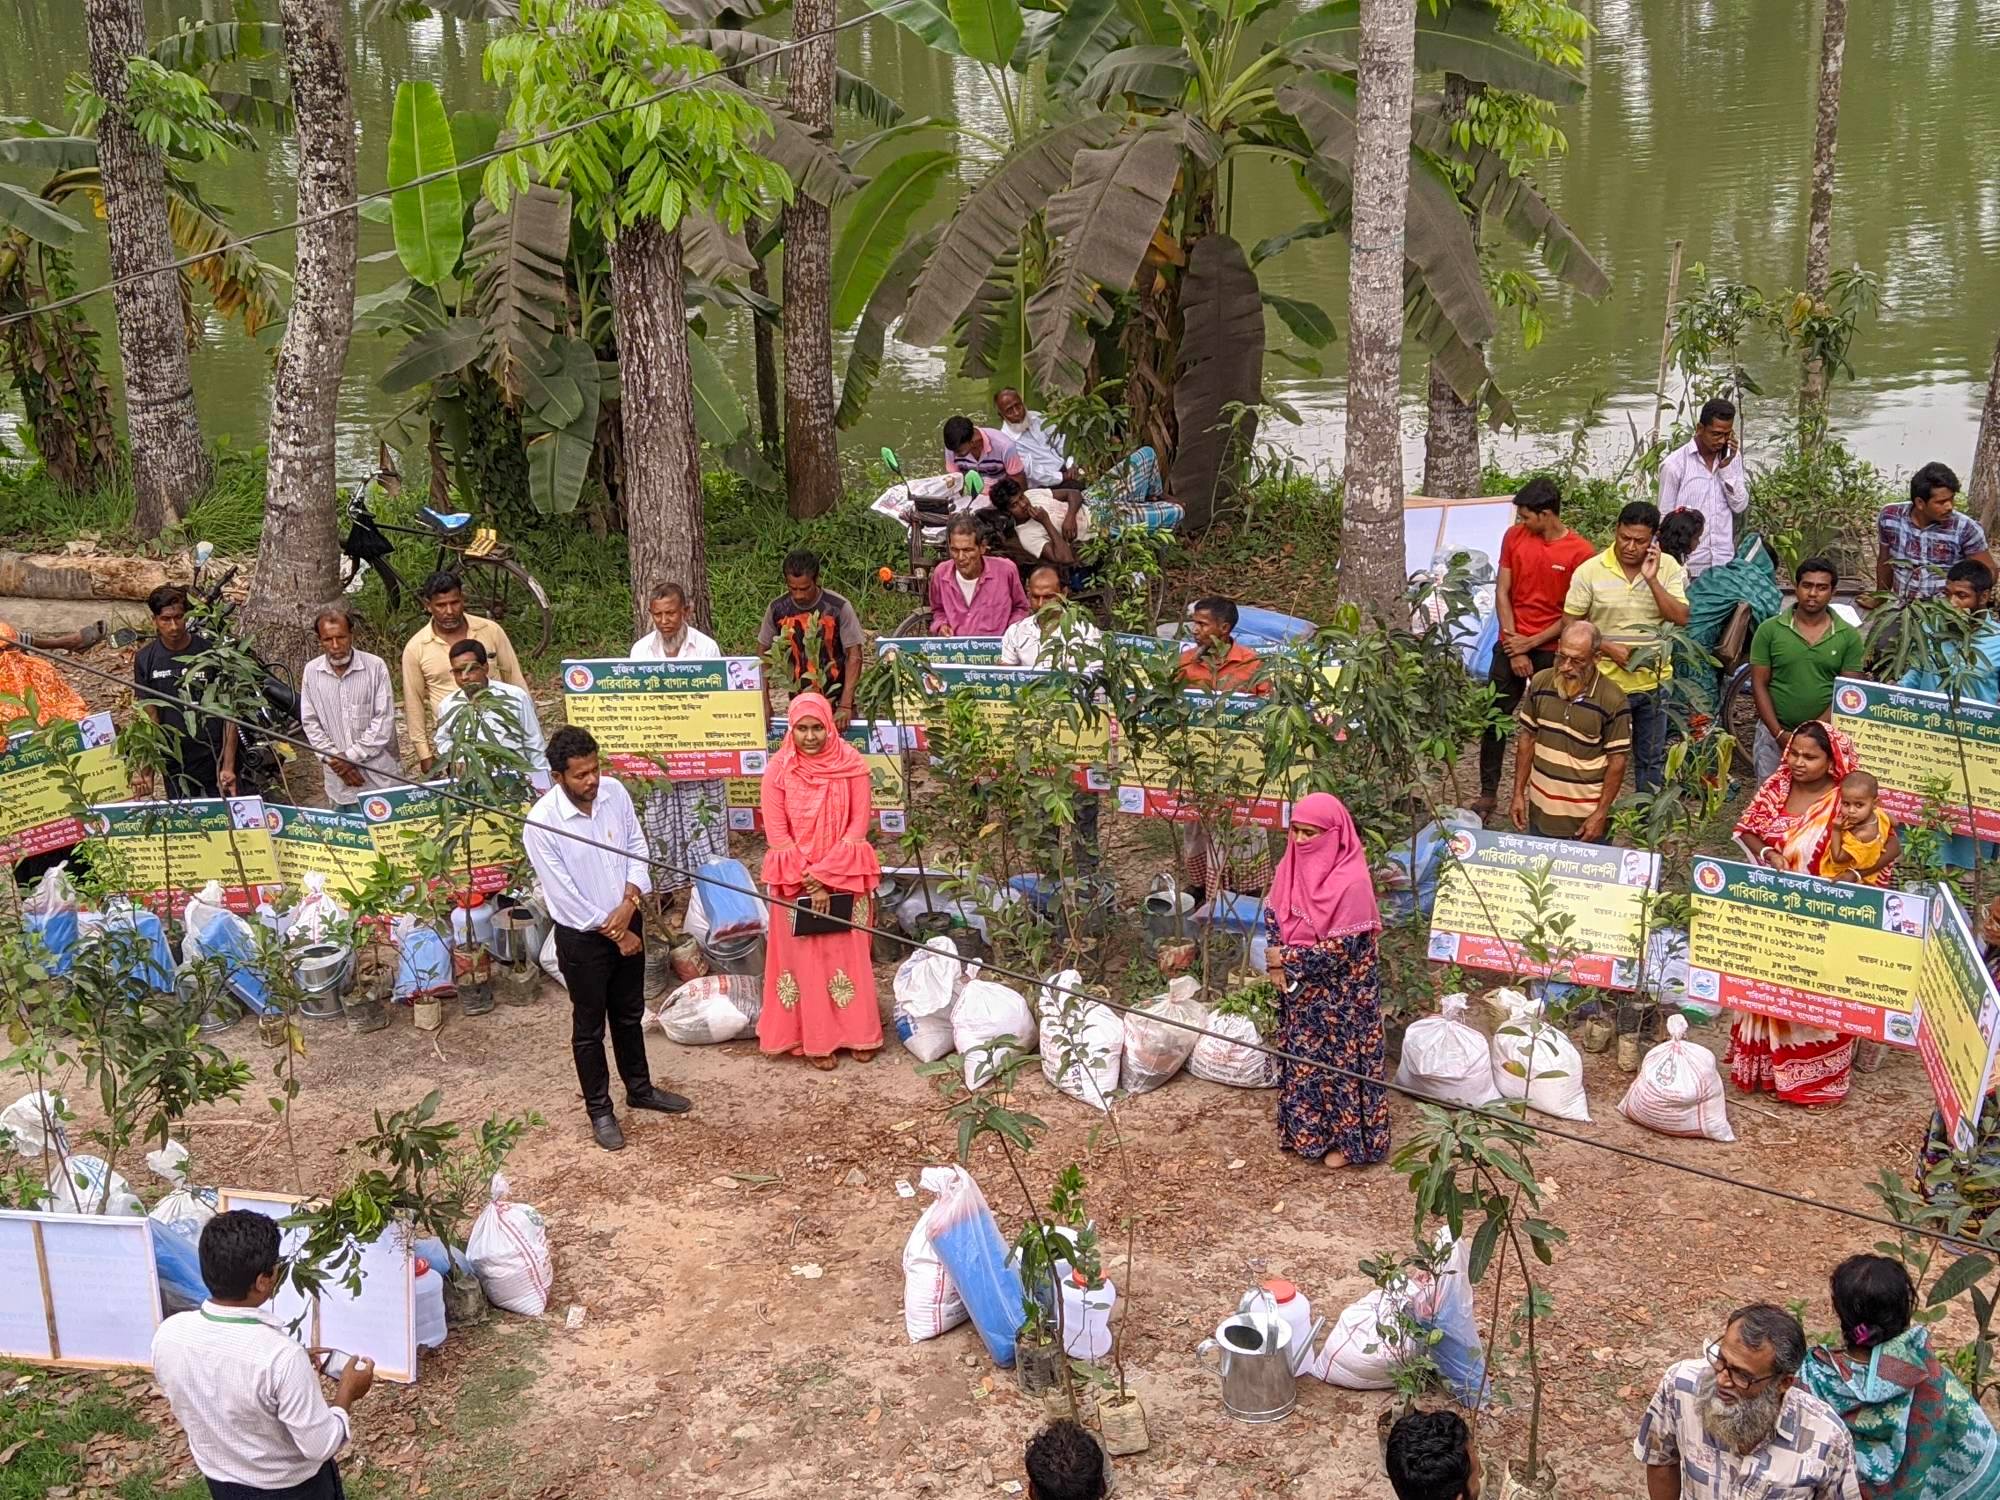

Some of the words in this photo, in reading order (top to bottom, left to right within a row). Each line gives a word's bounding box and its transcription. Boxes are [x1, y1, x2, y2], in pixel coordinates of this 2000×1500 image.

[921, 641, 941, 652] মুজিব
[945, 640, 968, 650] শতবর্ষ
[611, 664, 635, 675] মুজিব
[637, 664, 665, 673] শতবর্ষ
[668, 663, 702, 673] উপলক্ষে
[964, 671, 986, 682] মুজিব
[990, 670, 1015, 680] শতবর্ষ
[595, 675, 641, 690] পারিবারিক
[643, 675, 660, 691] পুষ্টি
[663, 678, 688, 688] বাগান
[690, 673, 722, 688] প্রদর্শনী
[1888, 692, 1914, 706] মুজিব
[1918, 699, 1949, 712] শতবর্ষ
[1869, 703, 1919, 722] পারিবারিক
[1922, 712, 1941, 729] পুষ্টি
[405, 789, 431, 801] মুজিব
[1498, 835, 1523, 849] মুজিব
[1526, 840, 1557, 853] শতবর্ষ
[1560, 843, 1598, 858] উপলক্ষে
[1478, 847, 1526, 866] পারিবারিক
[1581, 862, 1617, 878] প্রদর্শনী
[1747, 871, 1774, 884] মুজিব
[1777, 877, 1809, 891] শতবর্ষ
[1812, 882, 1854, 899] উপলক্ষে
[1728, 882, 1778, 903] পারিবারিক
[1782, 892, 1801, 916] পুষ্টি
[1805, 898, 1834, 915] বাগান
[1838, 905, 1876, 923] প্রদর্শনী
[1761, 910, 1775, 919] নাম
[1750, 921, 1764, 930] নাম
